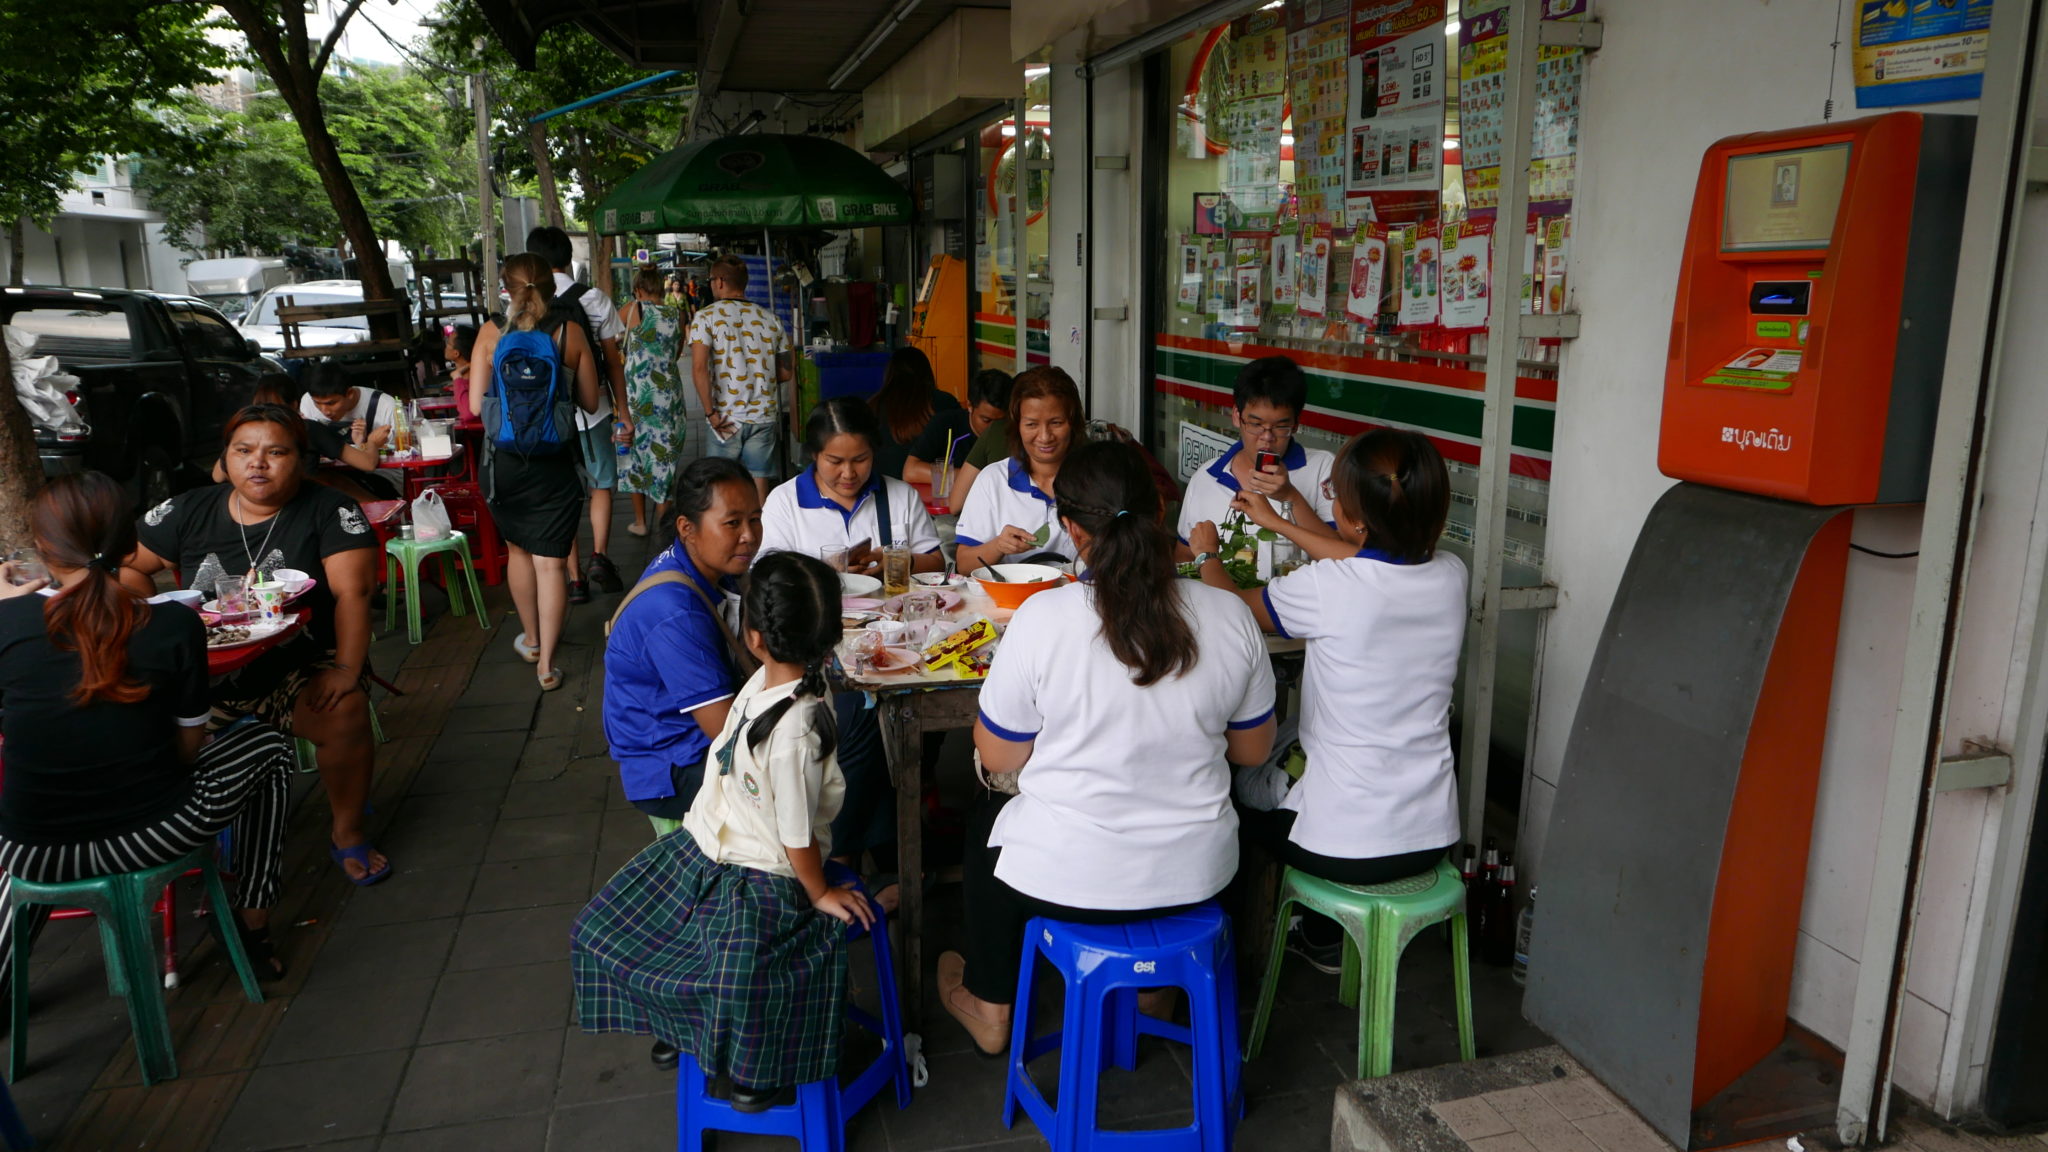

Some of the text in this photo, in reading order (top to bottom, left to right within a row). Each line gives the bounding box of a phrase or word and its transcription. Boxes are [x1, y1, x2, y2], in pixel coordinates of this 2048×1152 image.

[1417, 6, 1429, 23] 60
[1415, 55, 1424, 64] HD
[842, 202, 899, 217] GRABBIKE
[620, 211, 657, 225] GRABBIKE
[1735, 428, 1792, 451] บุญเติม
